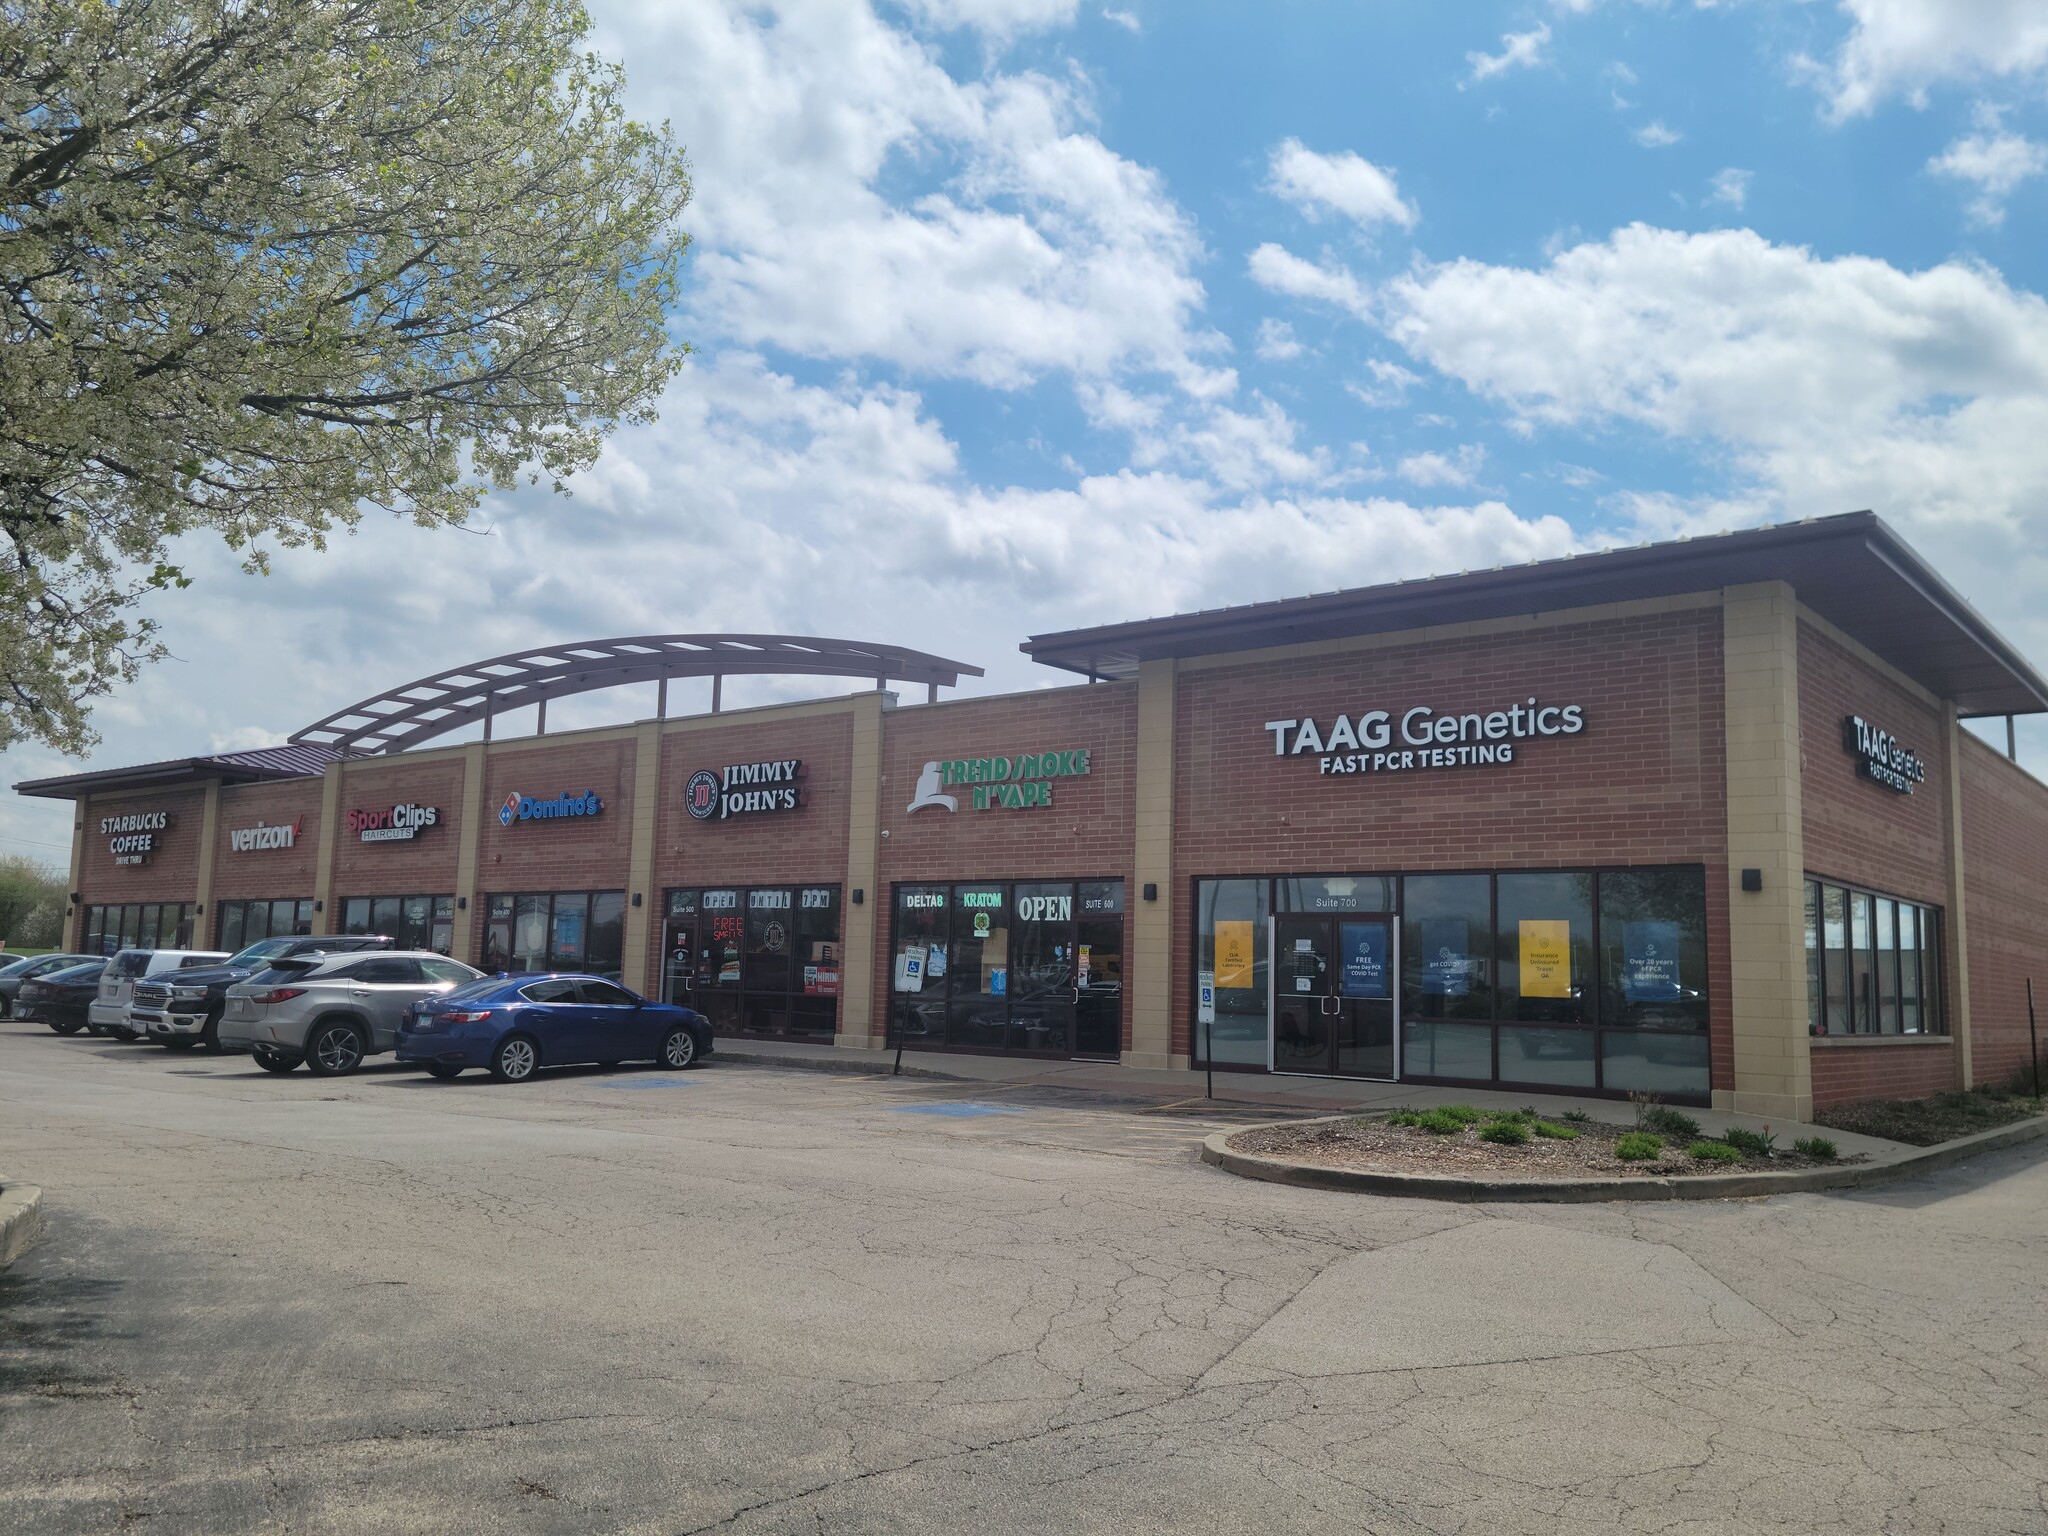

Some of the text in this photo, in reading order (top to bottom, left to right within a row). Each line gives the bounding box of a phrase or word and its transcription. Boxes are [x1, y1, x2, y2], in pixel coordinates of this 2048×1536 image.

[1264, 697, 1583, 756] TAAG Genetics
[1853, 715, 1888, 765] TAAG
[941, 749, 1092, 785] TREND SMOKE
[1320, 743, 1513, 775] FAST PCR TESTING
[722, 760, 797, 791] JIMMY
[519, 789, 599, 820] Domino's
[720, 788, 796, 819] JOHN'S
[101, 811, 166, 834] STARBUCKS
[231, 820, 295, 851] verizon
[363, 828, 412, 839] HAIRCUTS
[110, 834, 152, 854] COFFEE
[115, 856, 130, 865] DRIVE
[704, 895, 734, 907] OPEN
[750, 895, 789, 907] UNTIL
[963, 892, 1002, 907] KRATOM
[1019, 896, 1072, 921] OPEN
[1085, 899, 1114, 909] SUITE 600
[1316, 898, 1357, 907] Suite 700
[713, 917, 743, 931] FREE
[1355, 956, 1372, 964] FREE
[1361, 964, 1372, 972] Day
[817, 972, 838, 983] HIRIN
